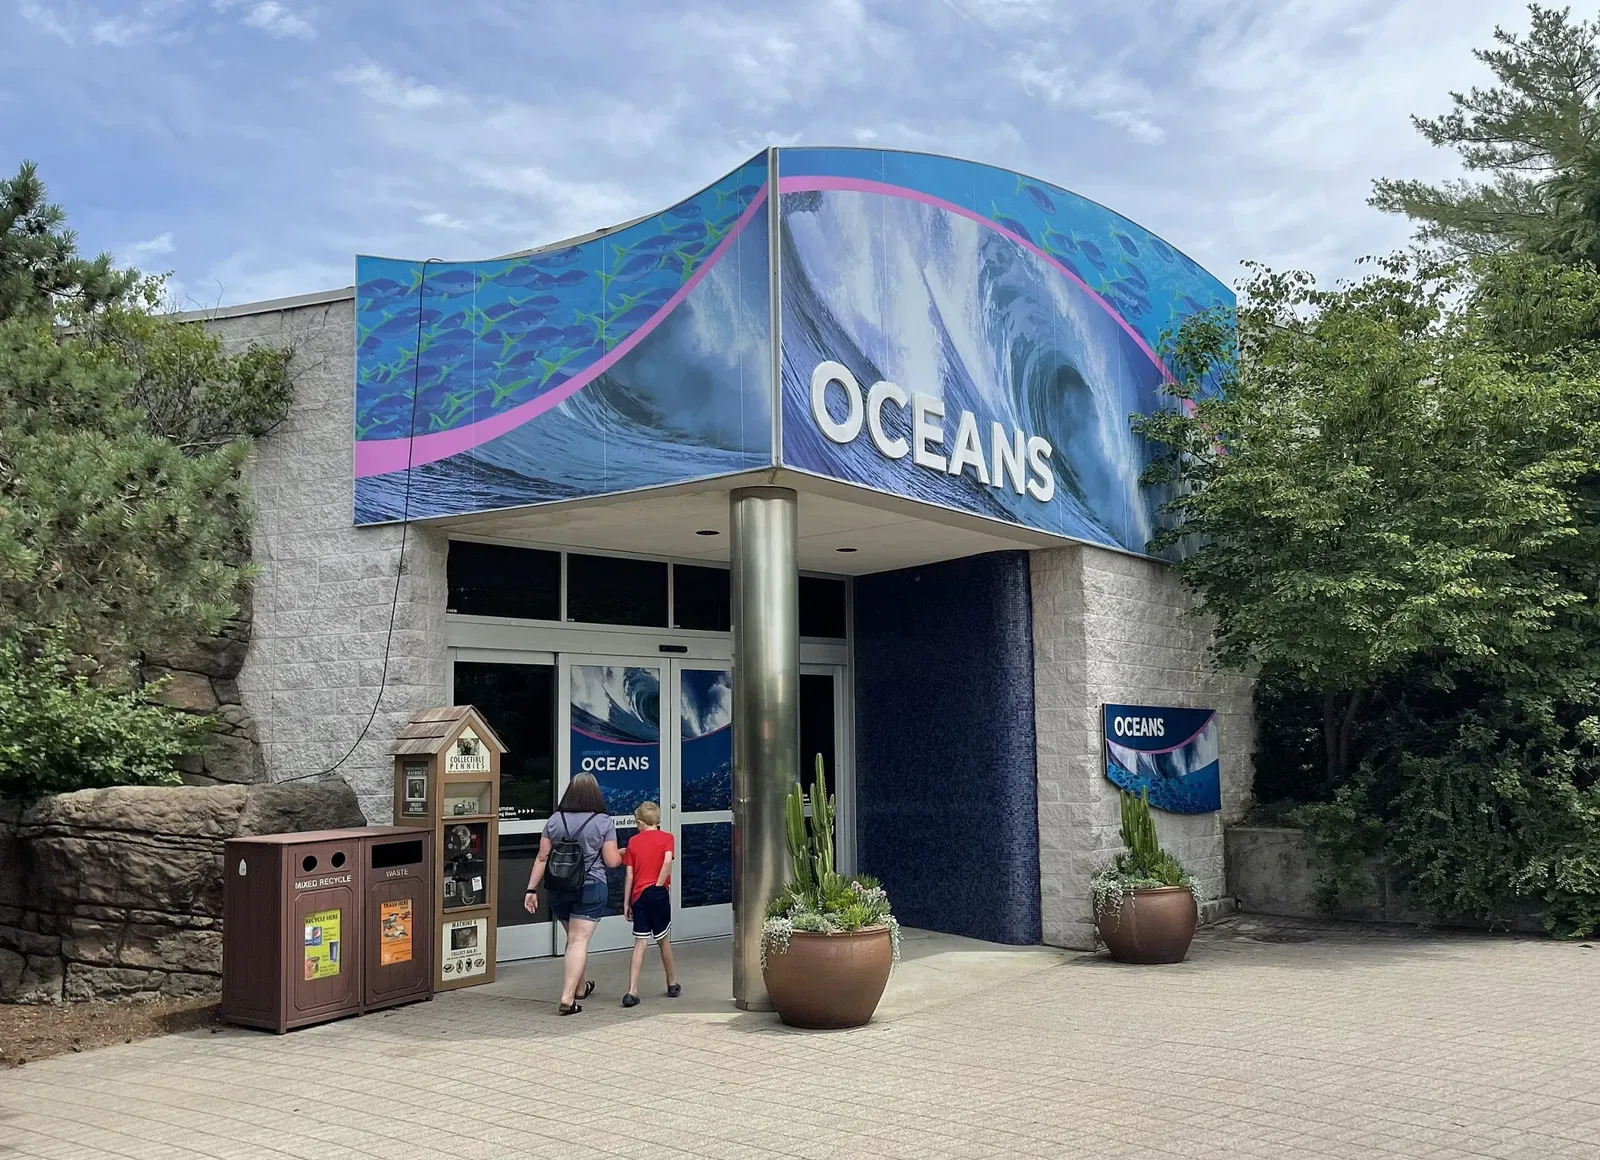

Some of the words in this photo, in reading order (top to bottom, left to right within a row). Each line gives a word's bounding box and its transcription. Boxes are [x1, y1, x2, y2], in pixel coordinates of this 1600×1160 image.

[811, 360, 1055, 502] OCEANS
[1114, 716, 1165, 737] OCEANS
[449, 755, 485, 764] COLLECTIBLE
[581, 756, 650, 772] OCEANS
[616, 817, 626, 826] and
[626, 817, 635, 826] dri
[385, 868, 409, 878] WASTE
[294, 879, 318, 890] MIXED
[319, 874, 352, 887] RECYCLE
[383, 901, 398, 909] TRASH
[305, 915, 326, 925] RECYCLE
[326, 913, 339, 922] HERE
